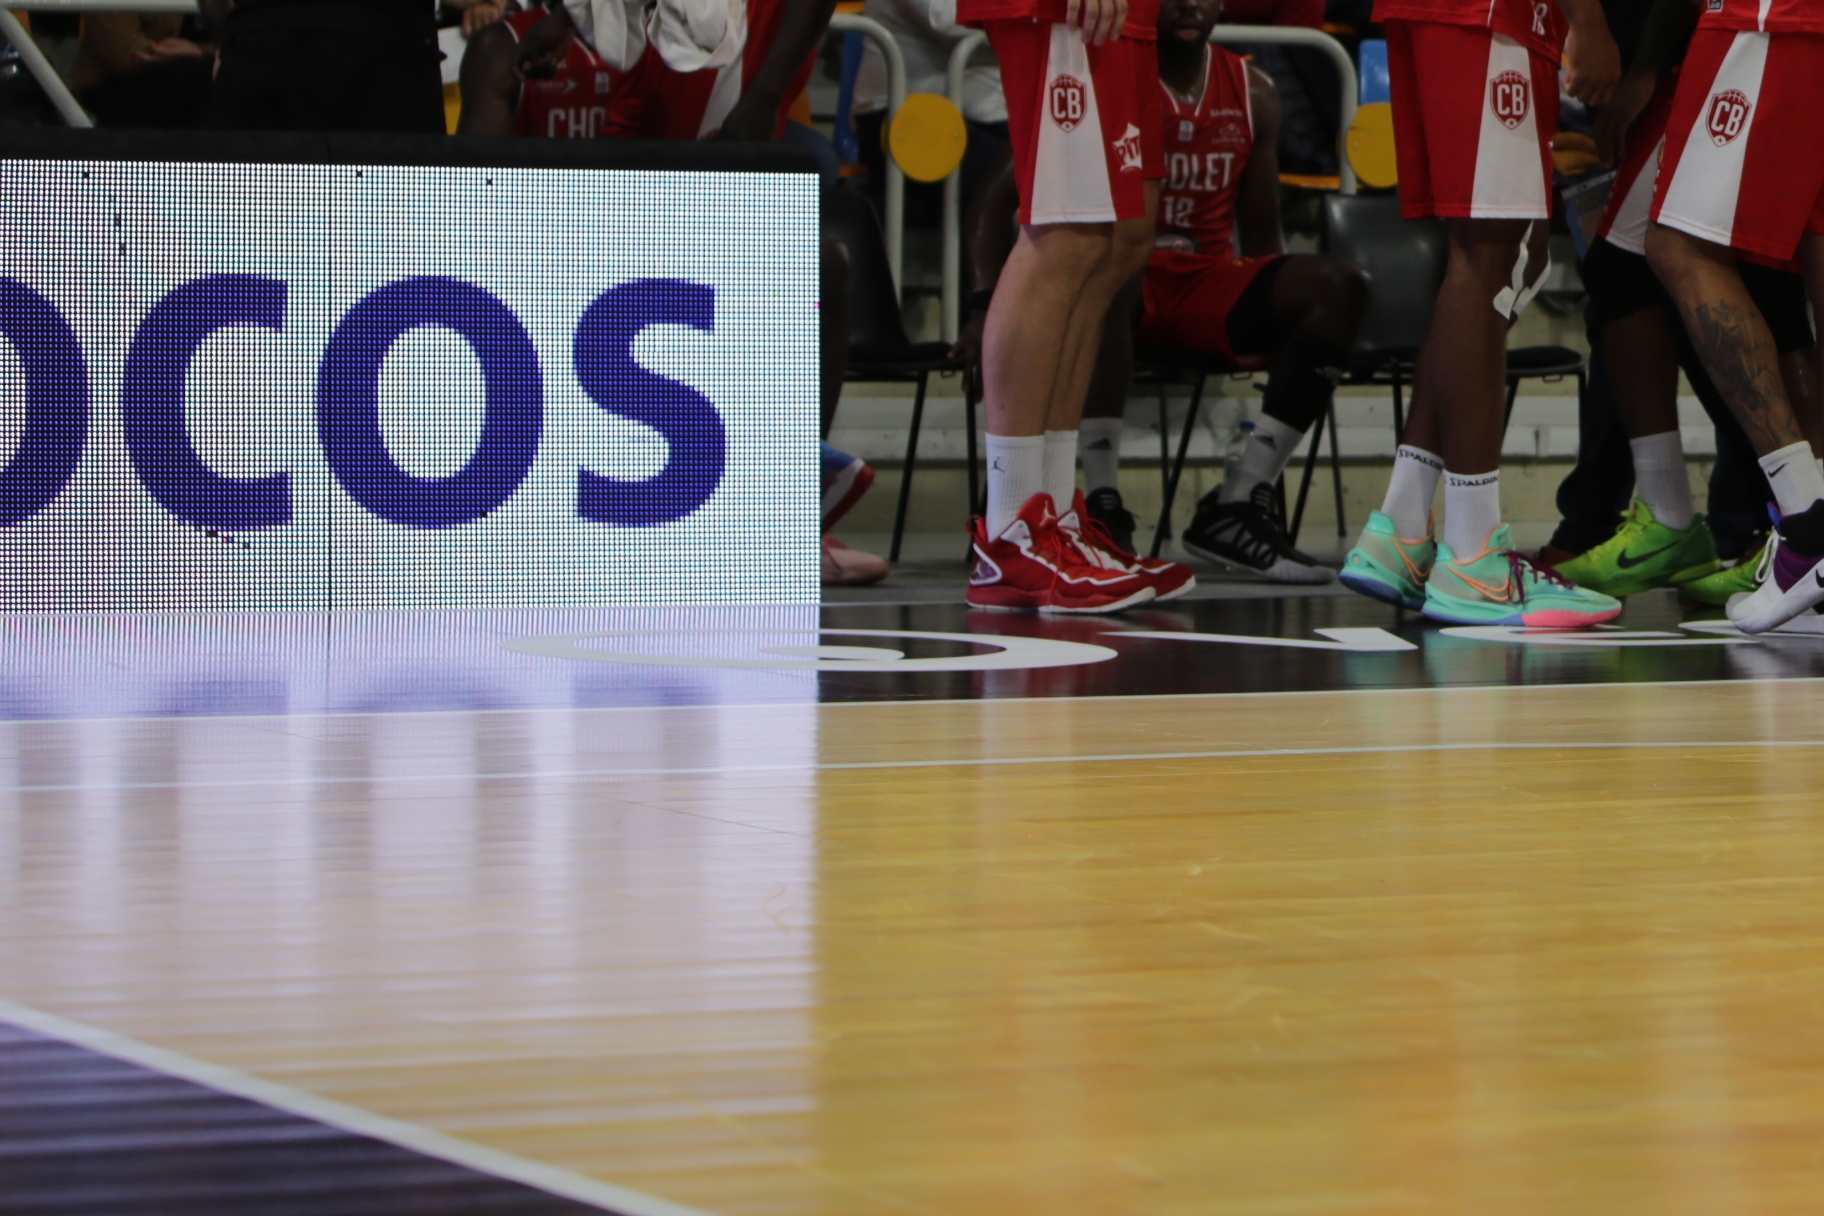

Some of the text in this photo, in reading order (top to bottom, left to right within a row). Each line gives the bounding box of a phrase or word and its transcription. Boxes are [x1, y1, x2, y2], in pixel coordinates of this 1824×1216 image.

[1052, 87, 1082, 120] CB
[1497, 84, 1525, 116] CB
[1710, 101, 1745, 137] CB
